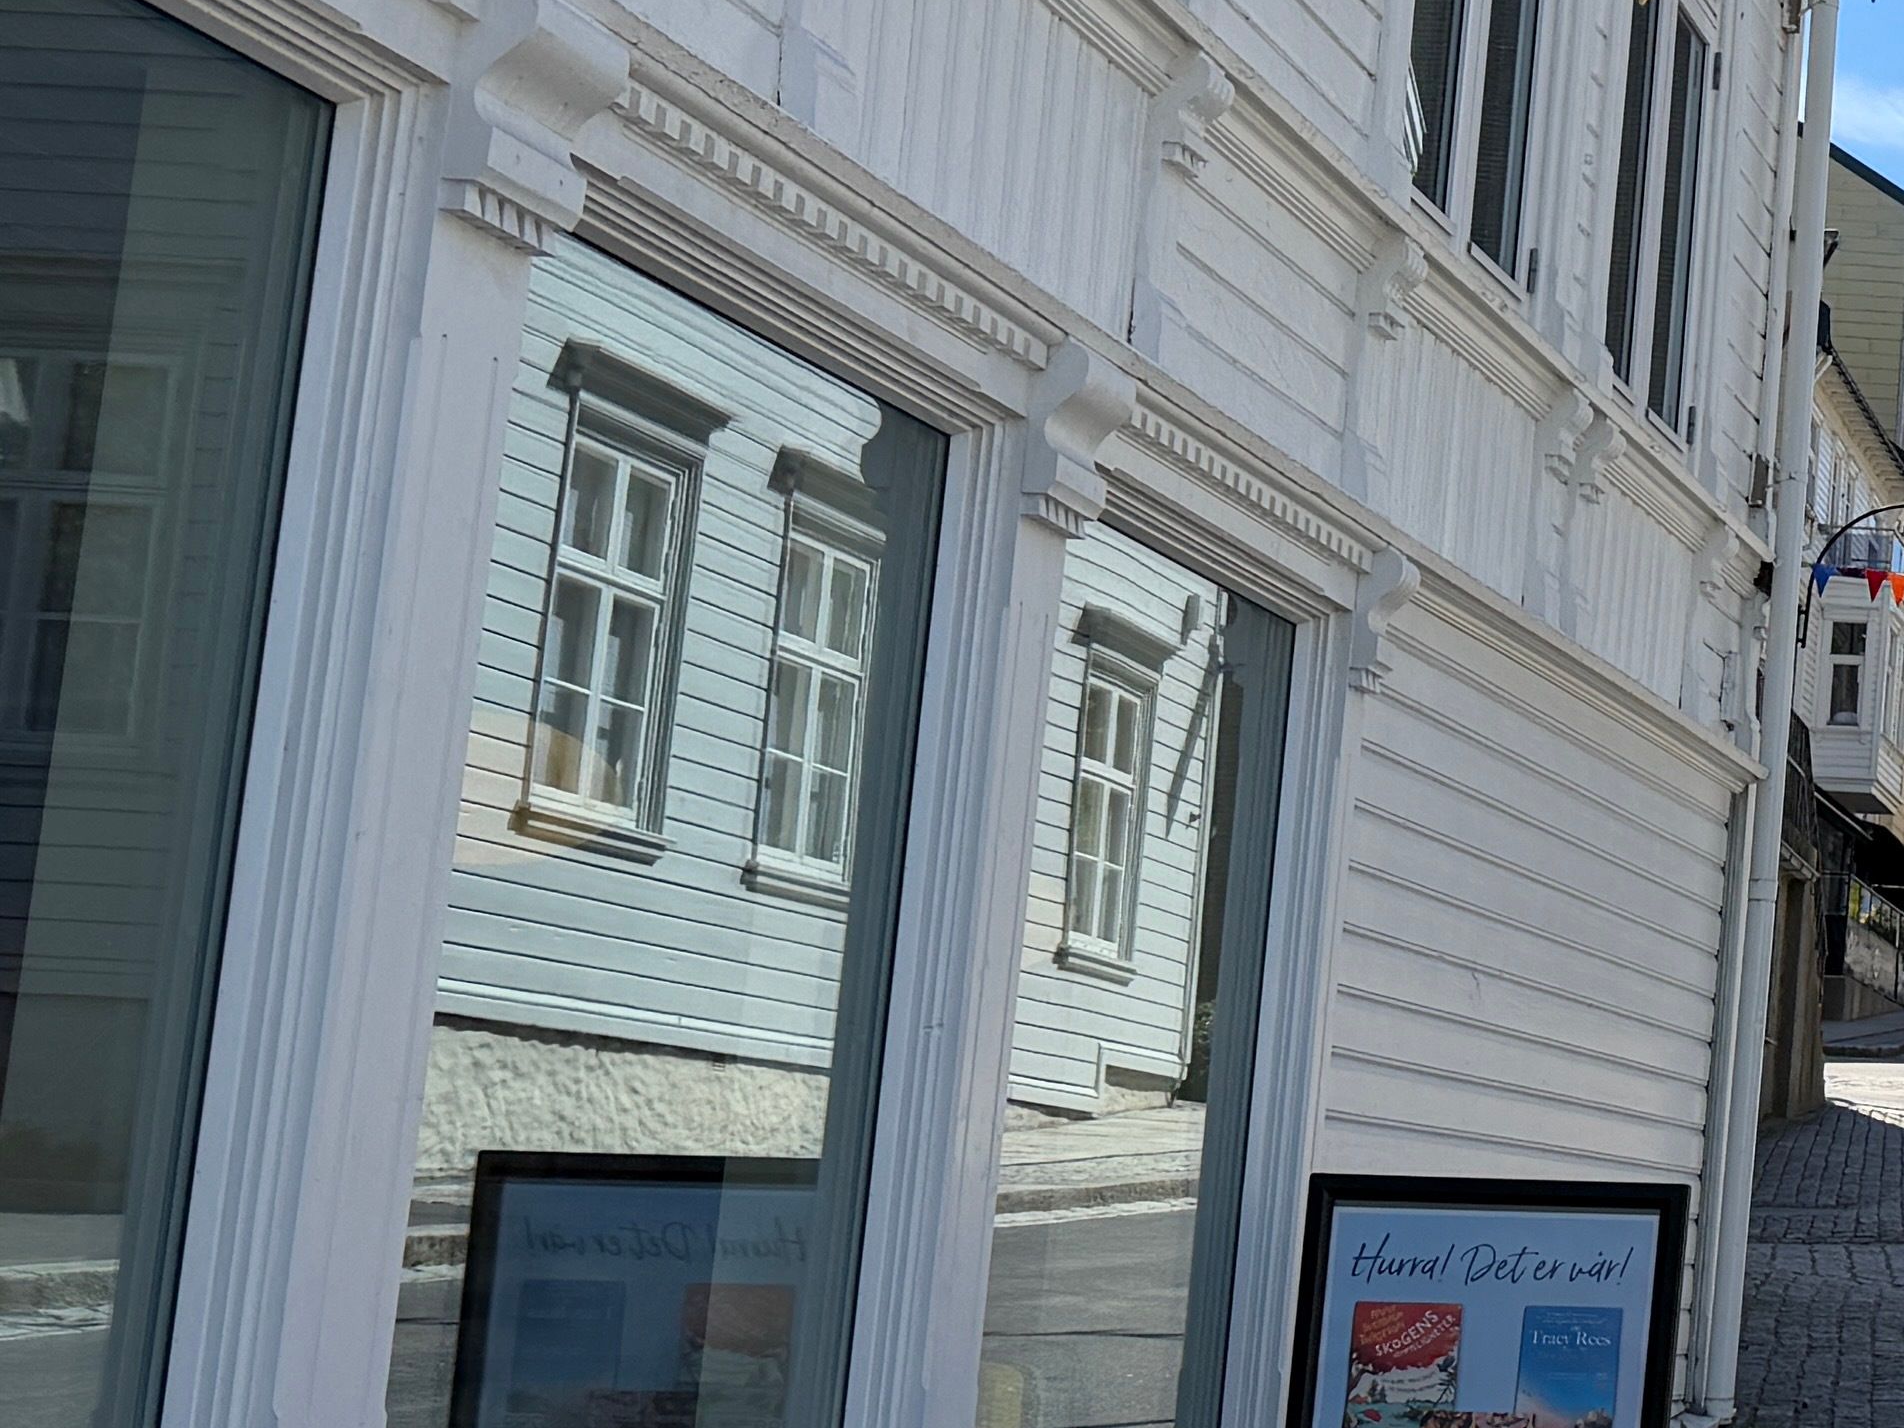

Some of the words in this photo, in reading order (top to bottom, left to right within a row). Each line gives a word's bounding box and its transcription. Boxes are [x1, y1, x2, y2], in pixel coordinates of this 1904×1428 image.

[1350, 1232, 1456, 1285] Hurra!
[1459, 1243, 1539, 1286] Det
[1532, 1259, 1564, 1281] er
[1567, 1246, 1635, 1285] vår!
[1375, 1309, 1440, 1357] SKOGENS
